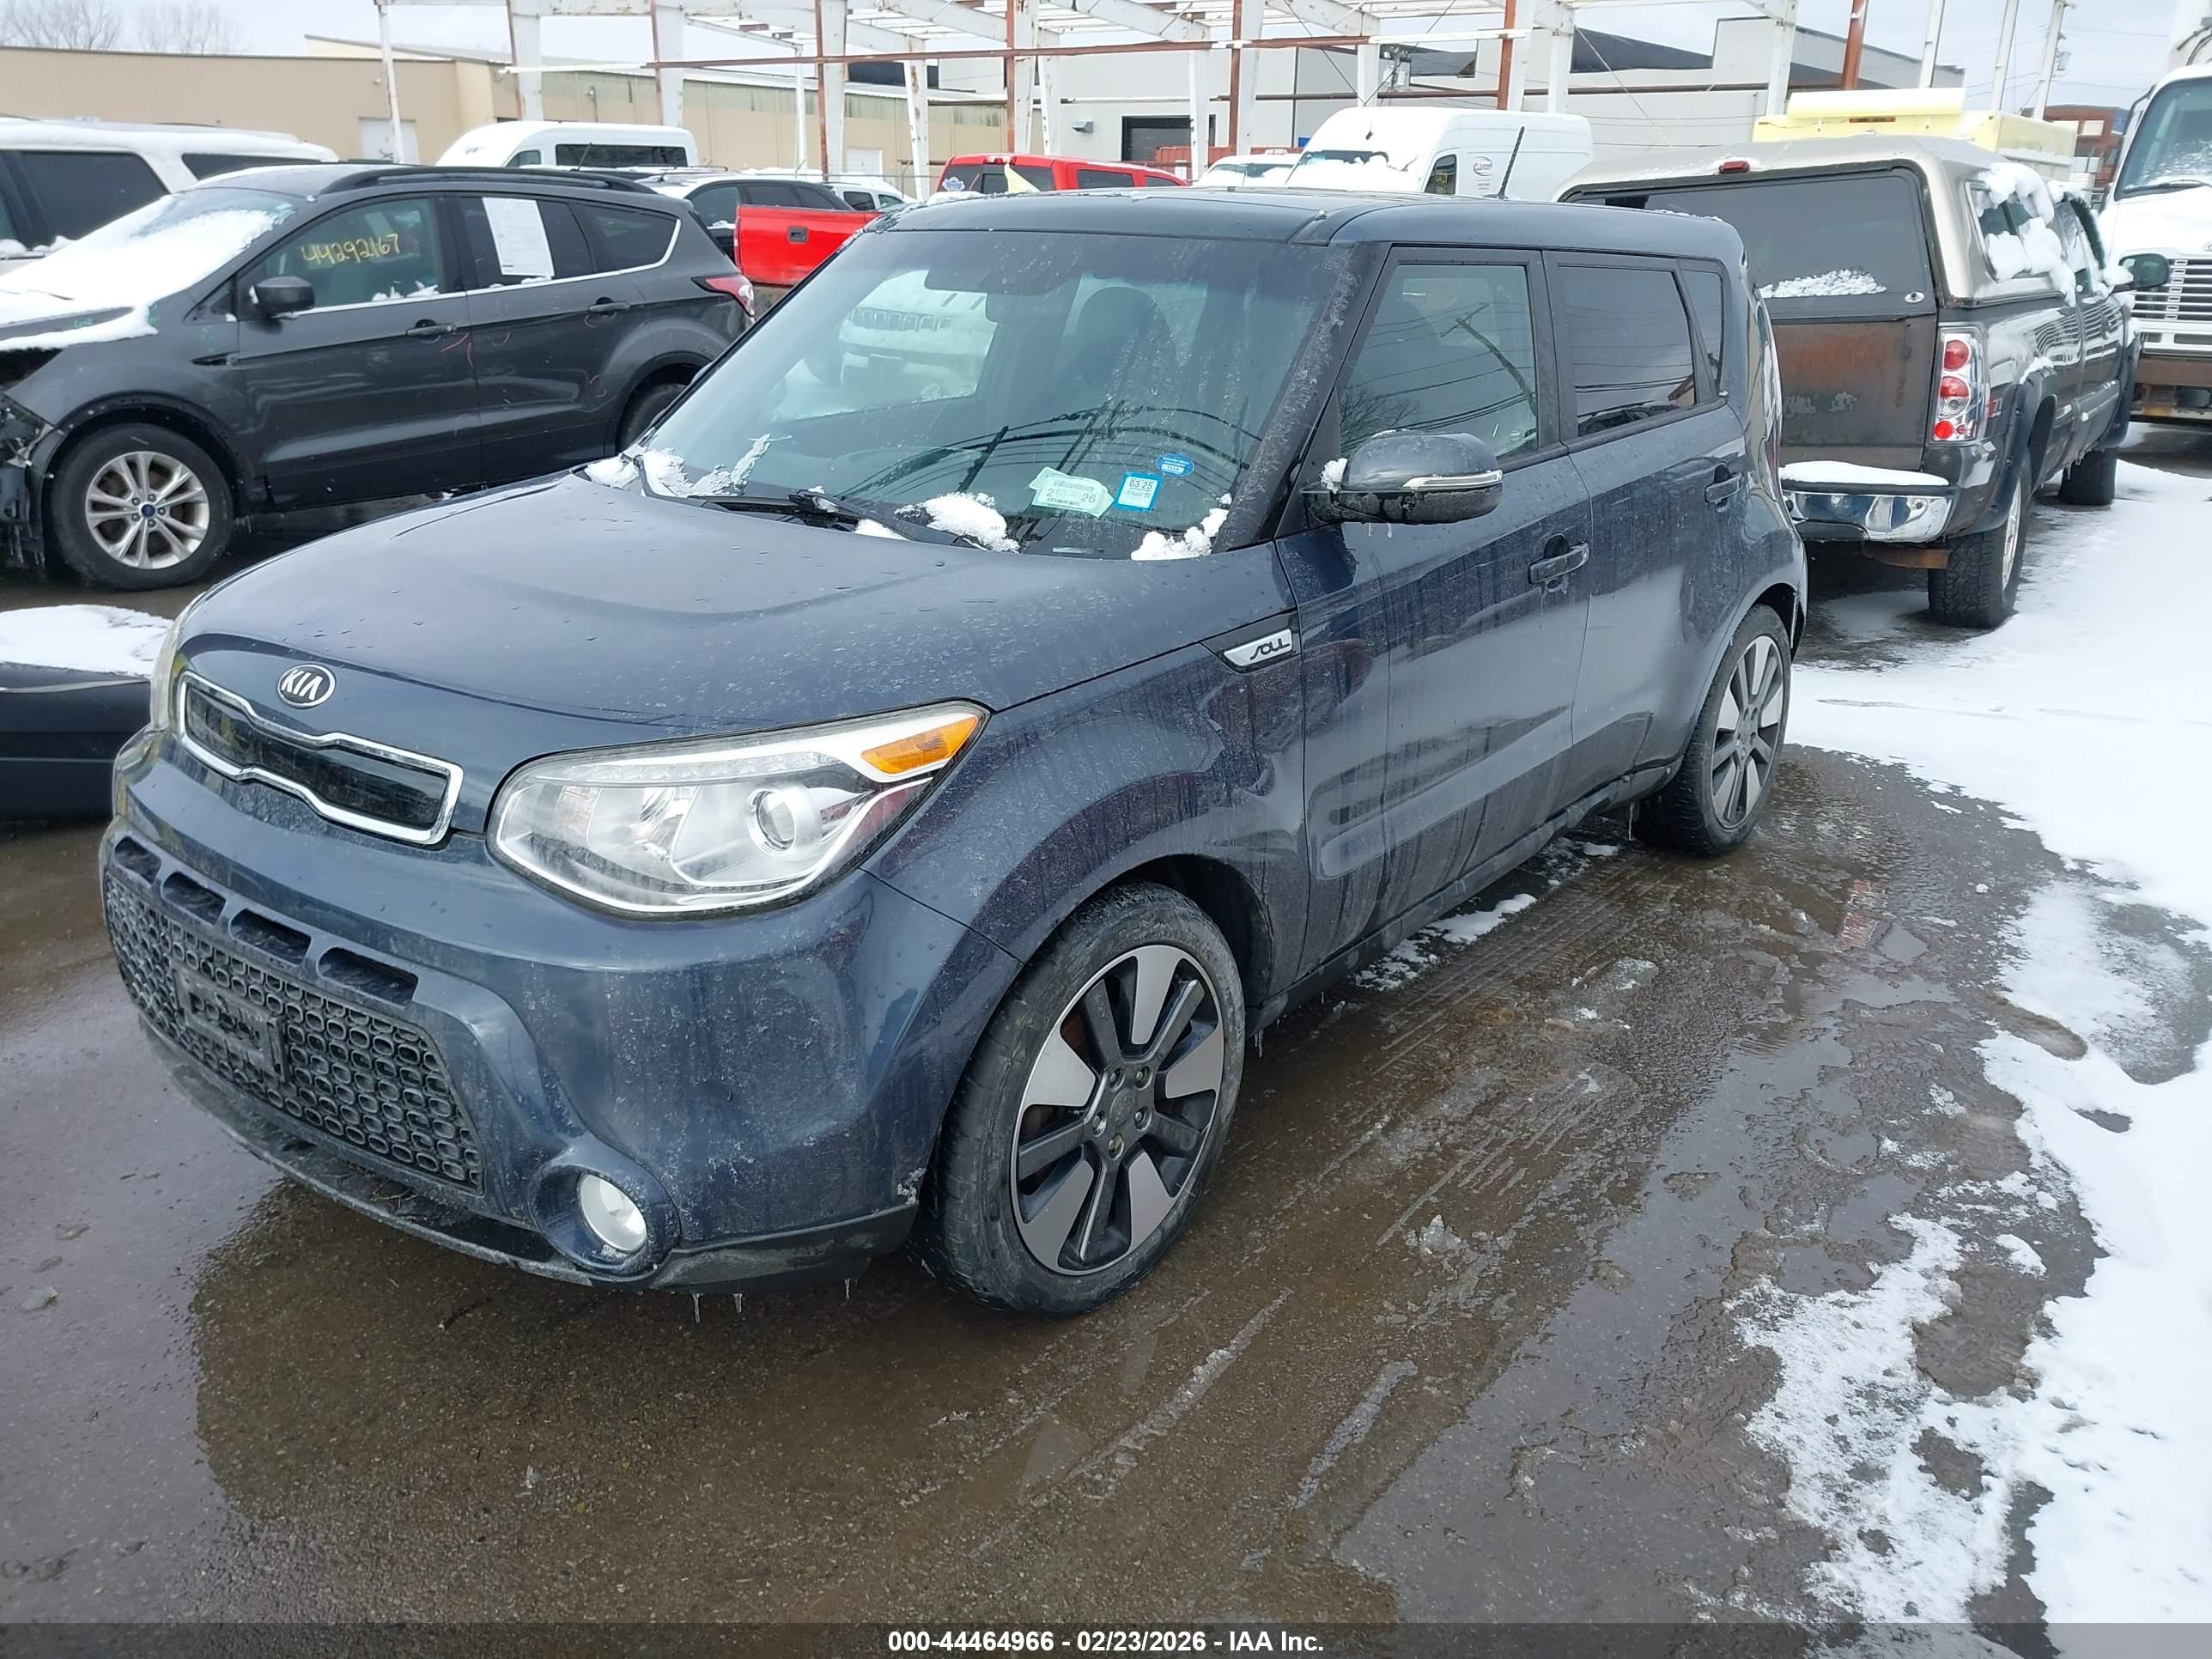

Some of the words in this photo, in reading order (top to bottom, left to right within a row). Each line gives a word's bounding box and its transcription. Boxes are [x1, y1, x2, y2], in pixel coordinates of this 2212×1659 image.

[301, 233, 400, 264] 44292167
[1046, 488, 1054, 497] 2
[1080, 493, 1097, 503] 26
[1129, 479, 1140, 488] 03
[1141, 480, 1154, 490] 25
[281, 669, 324, 701] KIA
